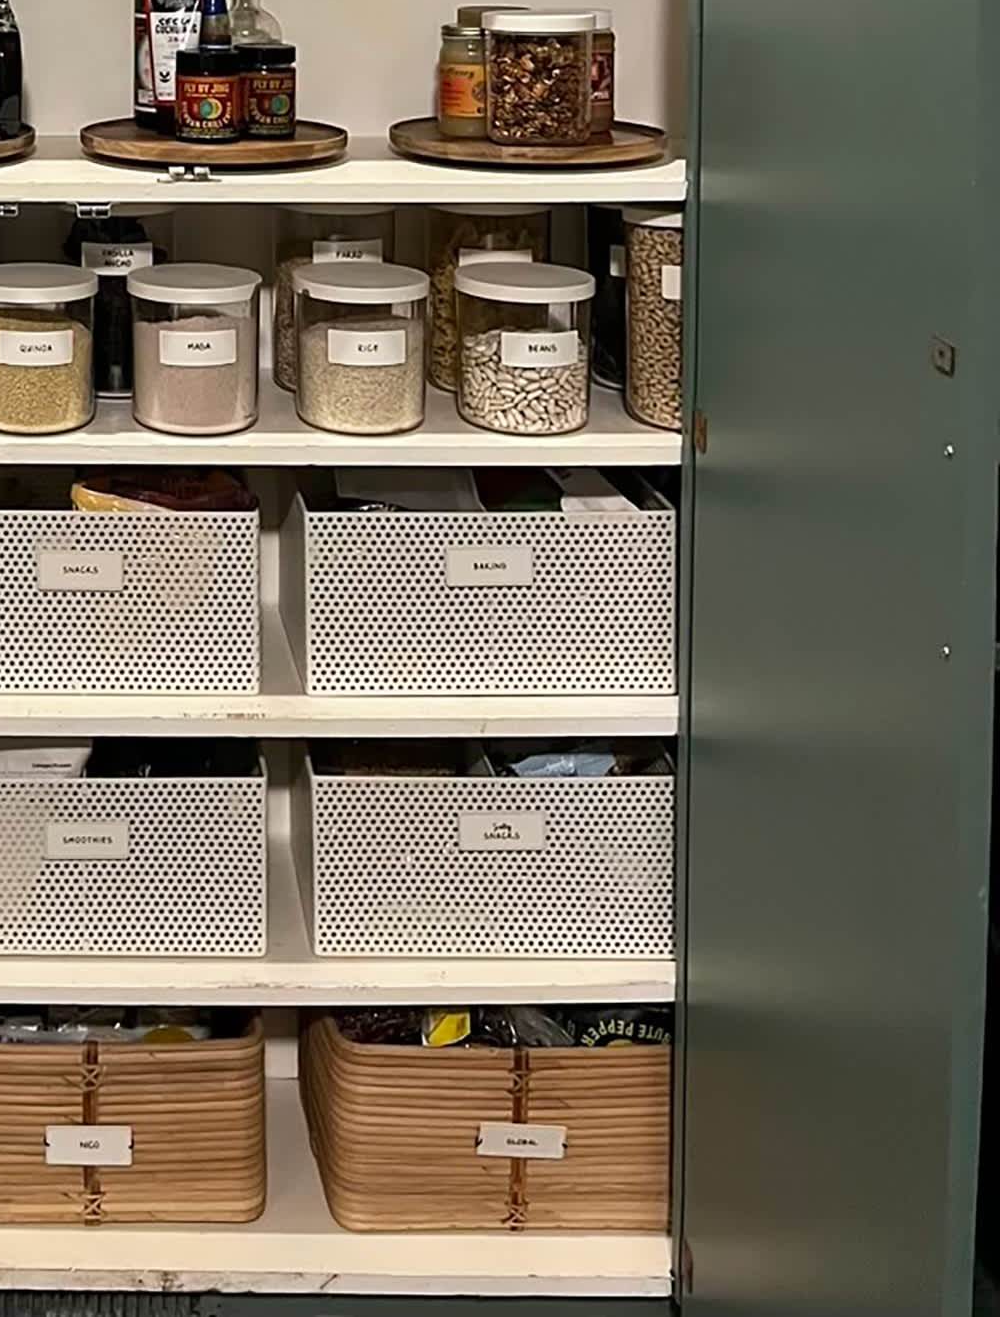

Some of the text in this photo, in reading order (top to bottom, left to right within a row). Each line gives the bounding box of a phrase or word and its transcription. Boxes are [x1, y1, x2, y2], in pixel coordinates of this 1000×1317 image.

[19, 344, 53, 353] QUINOA
[187, 342, 211, 351] MASA
[358, 344, 379, 353] RICE
[528, 344, 557, 353] BEANS
[62, 565, 99, 574] SNACKS
[473, 562, 507, 570] BAKING
[62, 836, 113, 844] SMOOTHIES
[483, 832, 520, 840] SNACKS
[580, 1018, 634, 1047] PEPPER
[79, 1140, 100, 1149] NICO
[506, 1137, 538, 1146] GLOBAL
